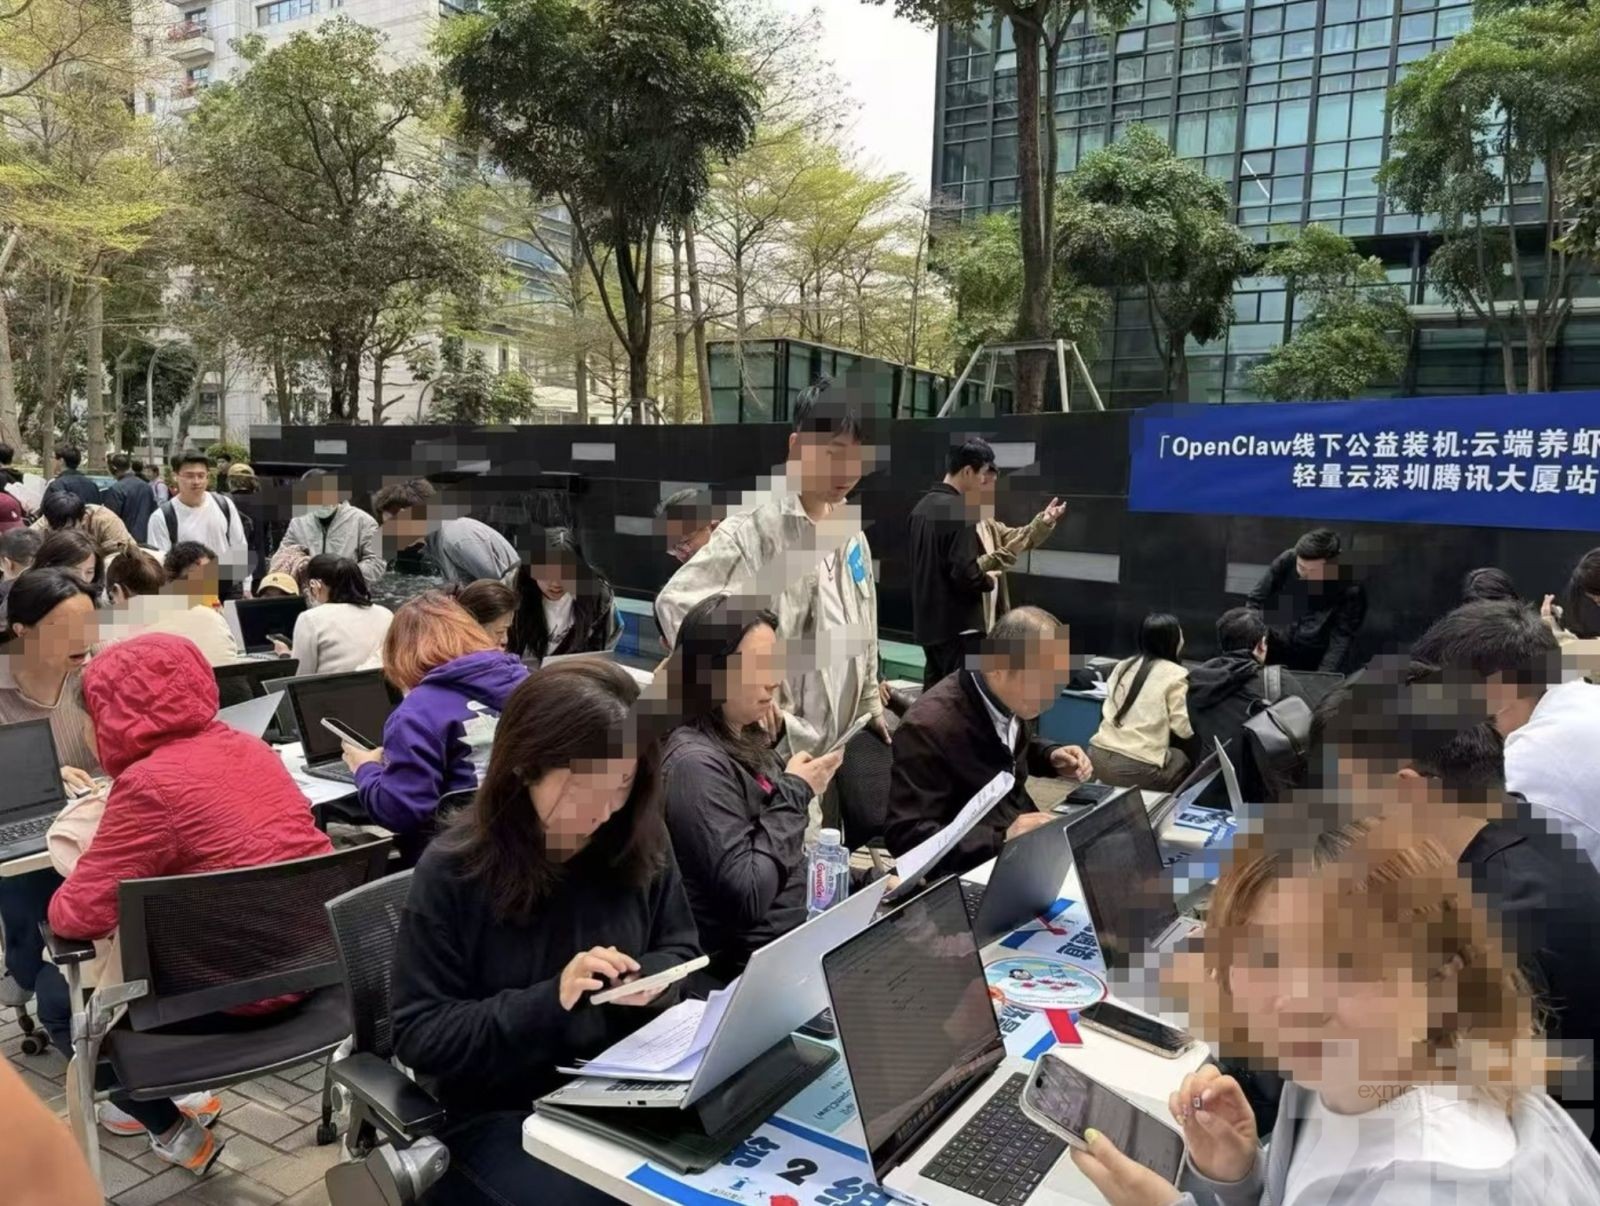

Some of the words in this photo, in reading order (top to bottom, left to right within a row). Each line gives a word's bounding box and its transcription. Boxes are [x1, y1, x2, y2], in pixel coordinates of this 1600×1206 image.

[1292, 462, 1599, 495] 轻量云深圳腾讯大厦站
[775, 1158, 819, 1187] 2
